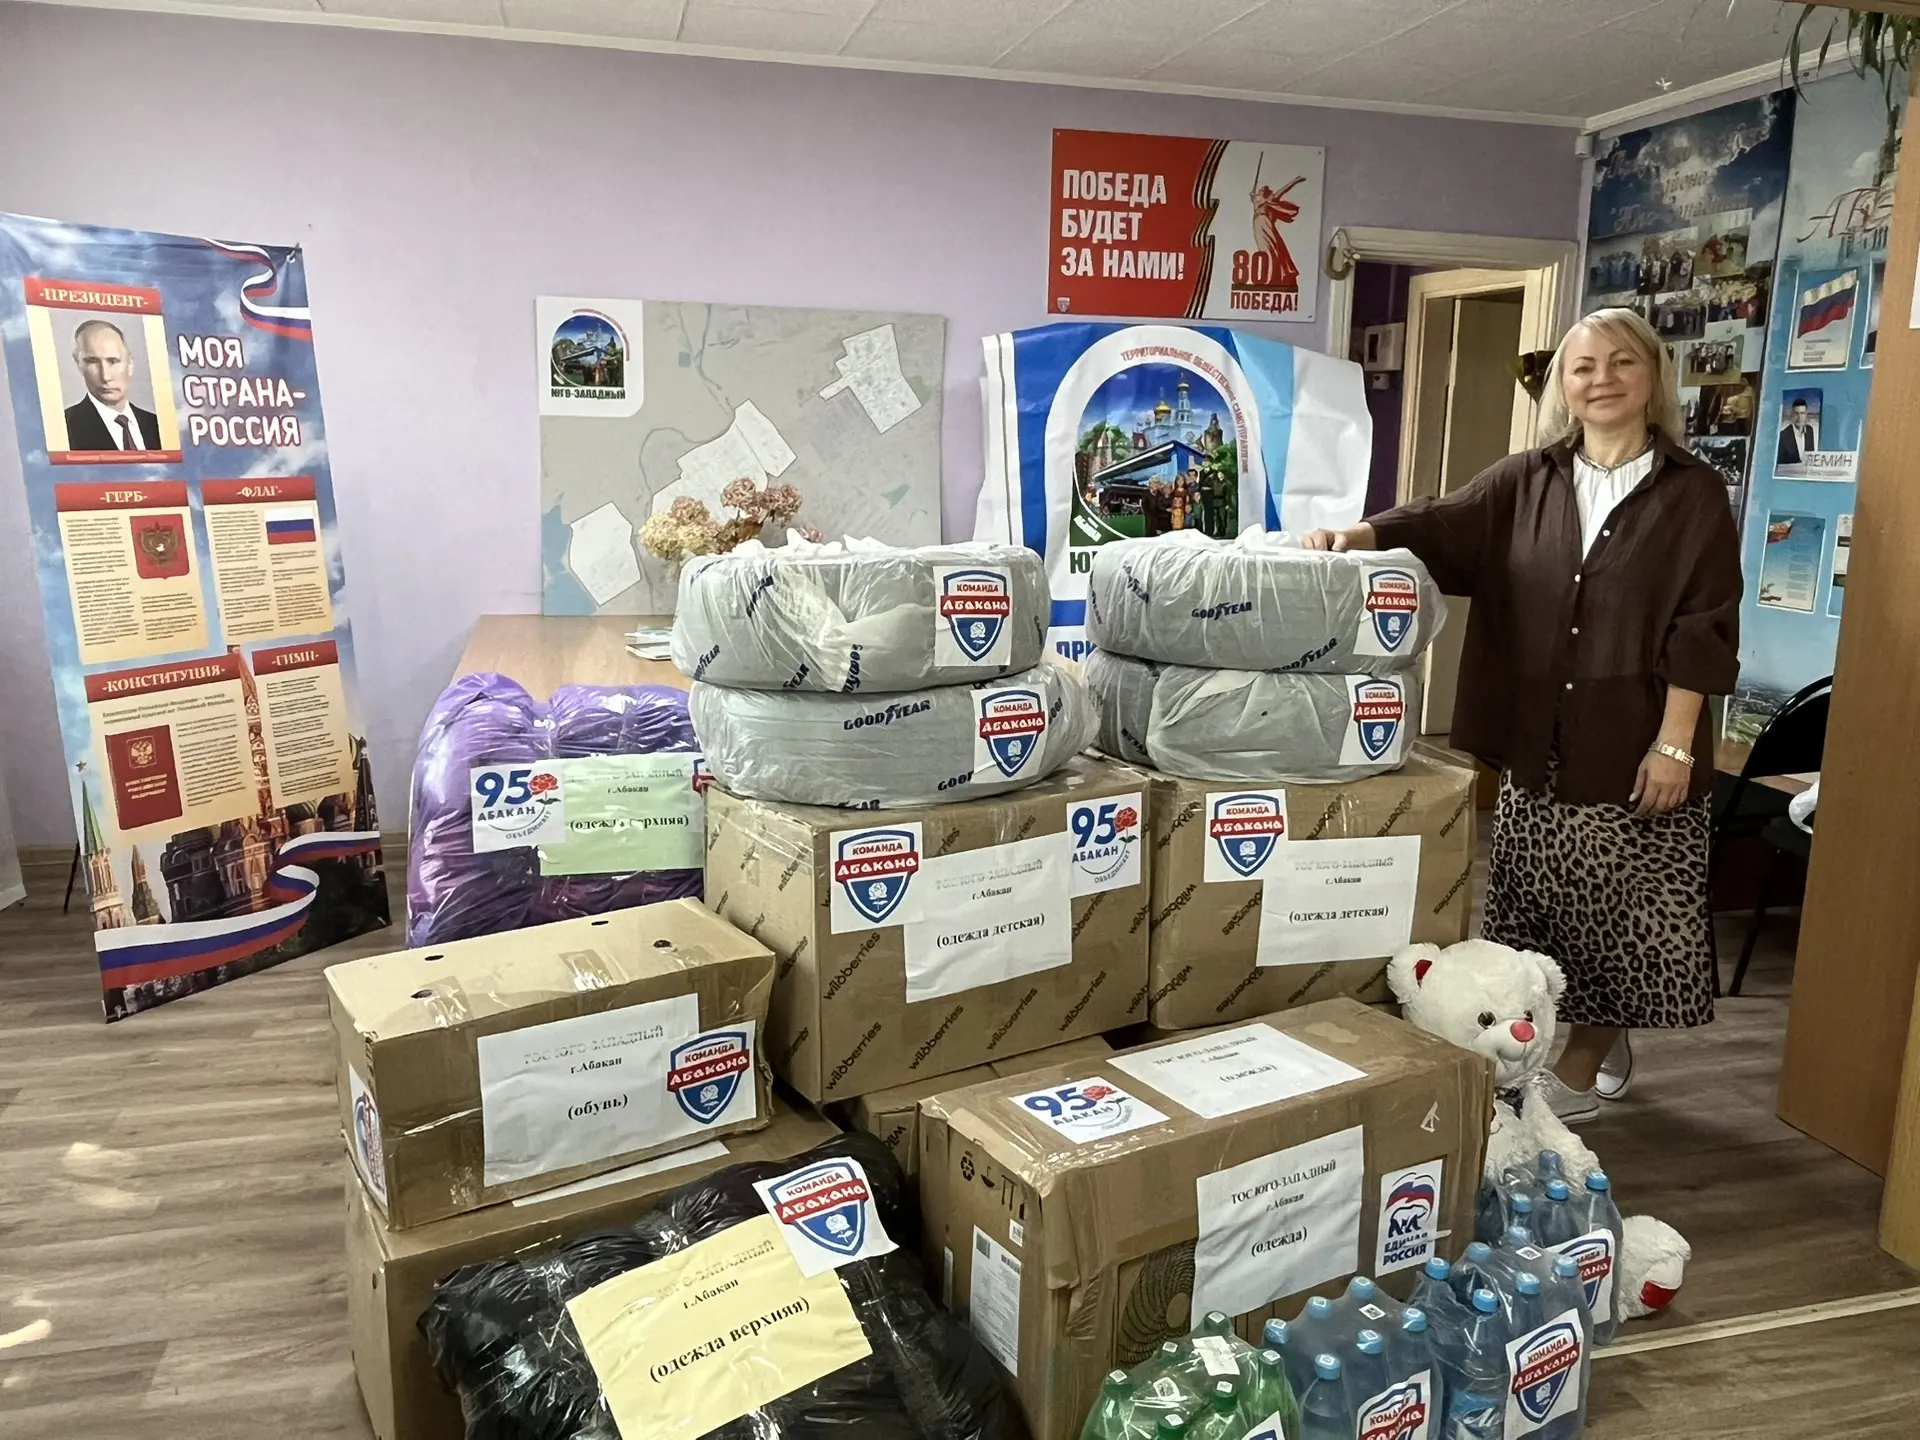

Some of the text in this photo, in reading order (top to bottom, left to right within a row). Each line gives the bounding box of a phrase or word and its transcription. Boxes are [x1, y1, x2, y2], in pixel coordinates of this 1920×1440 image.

[1062, 168, 1166, 207] ПОБЕДА
[1060, 208, 1143, 243] БУДЕТ
[1060, 246, 1185, 281] ЗА НАМИ!
[1229, 290, 1299, 313] ПОБЕДА!
[177, 335, 244, 369] МОЯ
[183, 375, 306, 409] СТРАНА-
[189, 414, 302, 447] РОССИЯ
[955, 582, 999, 593] КОМАНДА
[1378, 580, 1412, 591] КОМАНДА
[993, 701, 1034, 713] КОМАНДА
[1364, 691, 1397, 701] КОМАНДА
[843, 699, 931, 731] GOODYEAR
[475, 770, 533, 808] 95
[477, 805, 536, 822] АБАКАН
[1071, 803, 1119, 849] 95
[1226, 805, 1270, 816] КОМАНДА
[852, 842, 904, 856] КОМАНДА
[1071, 845, 1119, 864] АБАКАН
[972, 886, 1012, 901] г.Абакан
[1289, 905, 1389, 924] (одежда детская)
[936, 912, 1045, 949] (одежда детская)
[823, 931, 881, 1001] wildberries
[1060, 969, 1107, 1031] wildberries
[987, 986, 1039, 1051] wildberries
[684, 1042, 736, 1064] КОМАНДА
[909, 1004, 964, 1071] wildberries
[570, 1057, 622, 1075] г.Абакан
[825, 1021, 882, 1091] wildberries
[568, 1093, 629, 1121] (обувь)
[1024, 1087, 1098, 1118] 95
[785, 1171, 845, 1199] КОМАНДА
[1231, 1158, 1337, 1205] ТОС ЮГО-ЗАПАДНЫЙ
[1251, 1226, 1308, 1258] (одежда)
[1382, 1242, 1428, 1266] РОССИЯ
[683, 1279, 739, 1309] г.Абакан
[649, 1296, 811, 1384] (одежда верхняя)
[1527, 1337, 1569, 1364] КОМАНДА
